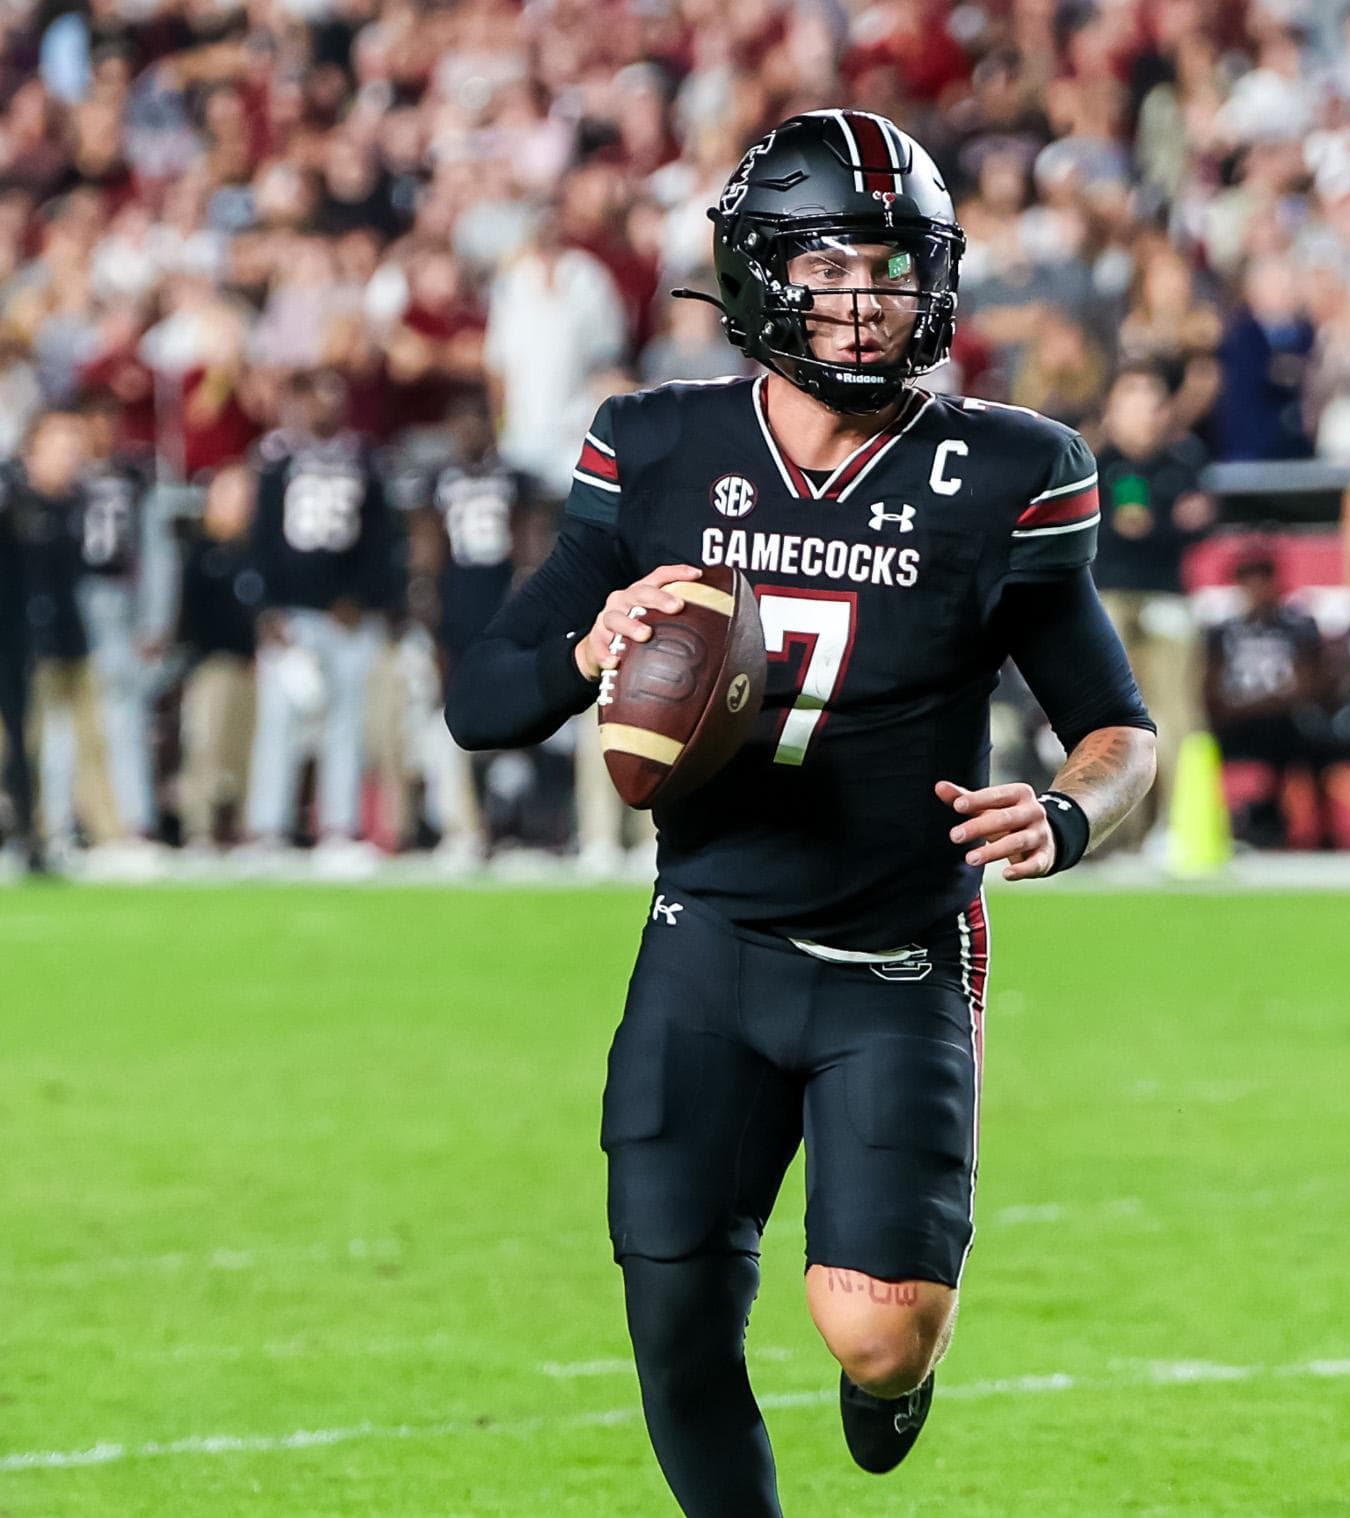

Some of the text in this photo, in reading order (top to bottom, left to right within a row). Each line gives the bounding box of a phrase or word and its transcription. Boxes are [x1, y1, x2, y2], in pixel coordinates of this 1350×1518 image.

[713, 475, 755, 518] SEC
[929, 439, 968, 496] C
[701, 527, 921, 588] GAMECOCKS
[755, 585, 858, 767] 7
